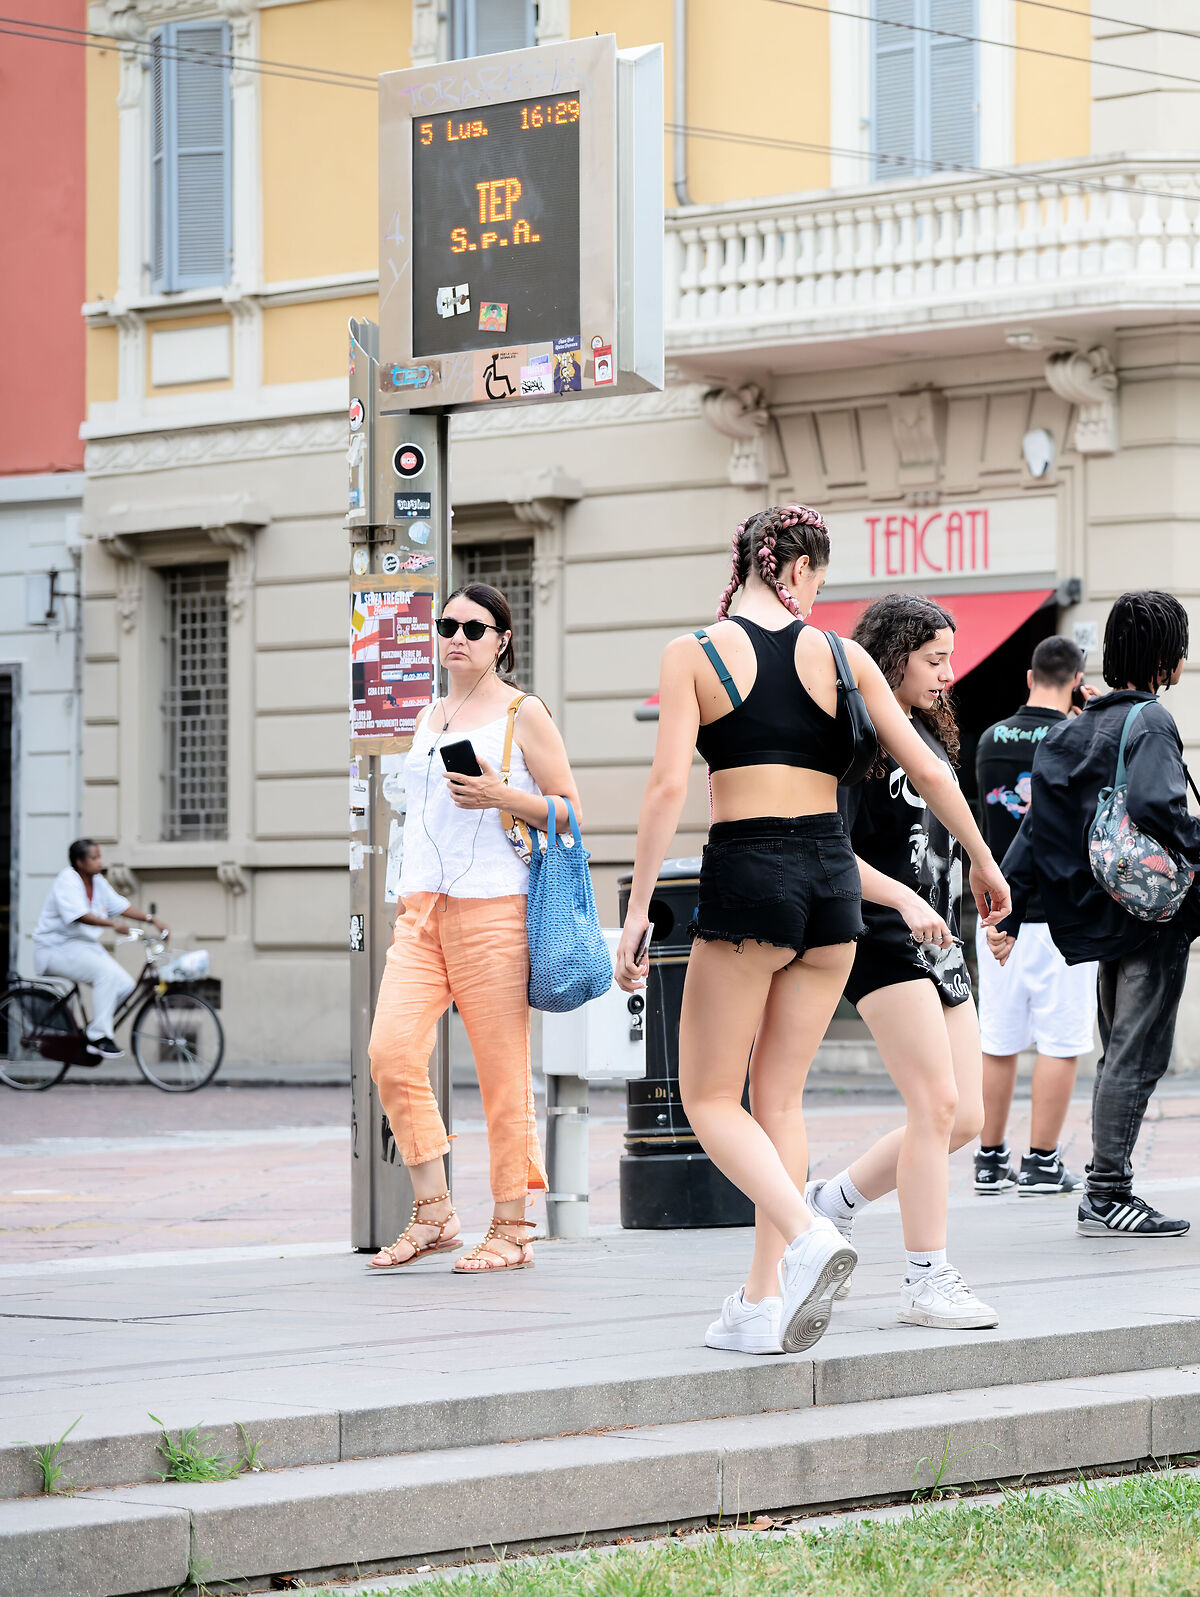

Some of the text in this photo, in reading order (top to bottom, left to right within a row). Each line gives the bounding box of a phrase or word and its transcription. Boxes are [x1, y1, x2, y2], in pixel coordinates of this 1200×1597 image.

[420, 100, 580, 145] 5 Lug. 16:29
[476, 177, 522, 224] TEP
[450, 219, 541, 253] S.p.A.
[865, 509, 989, 577] TENCATI
